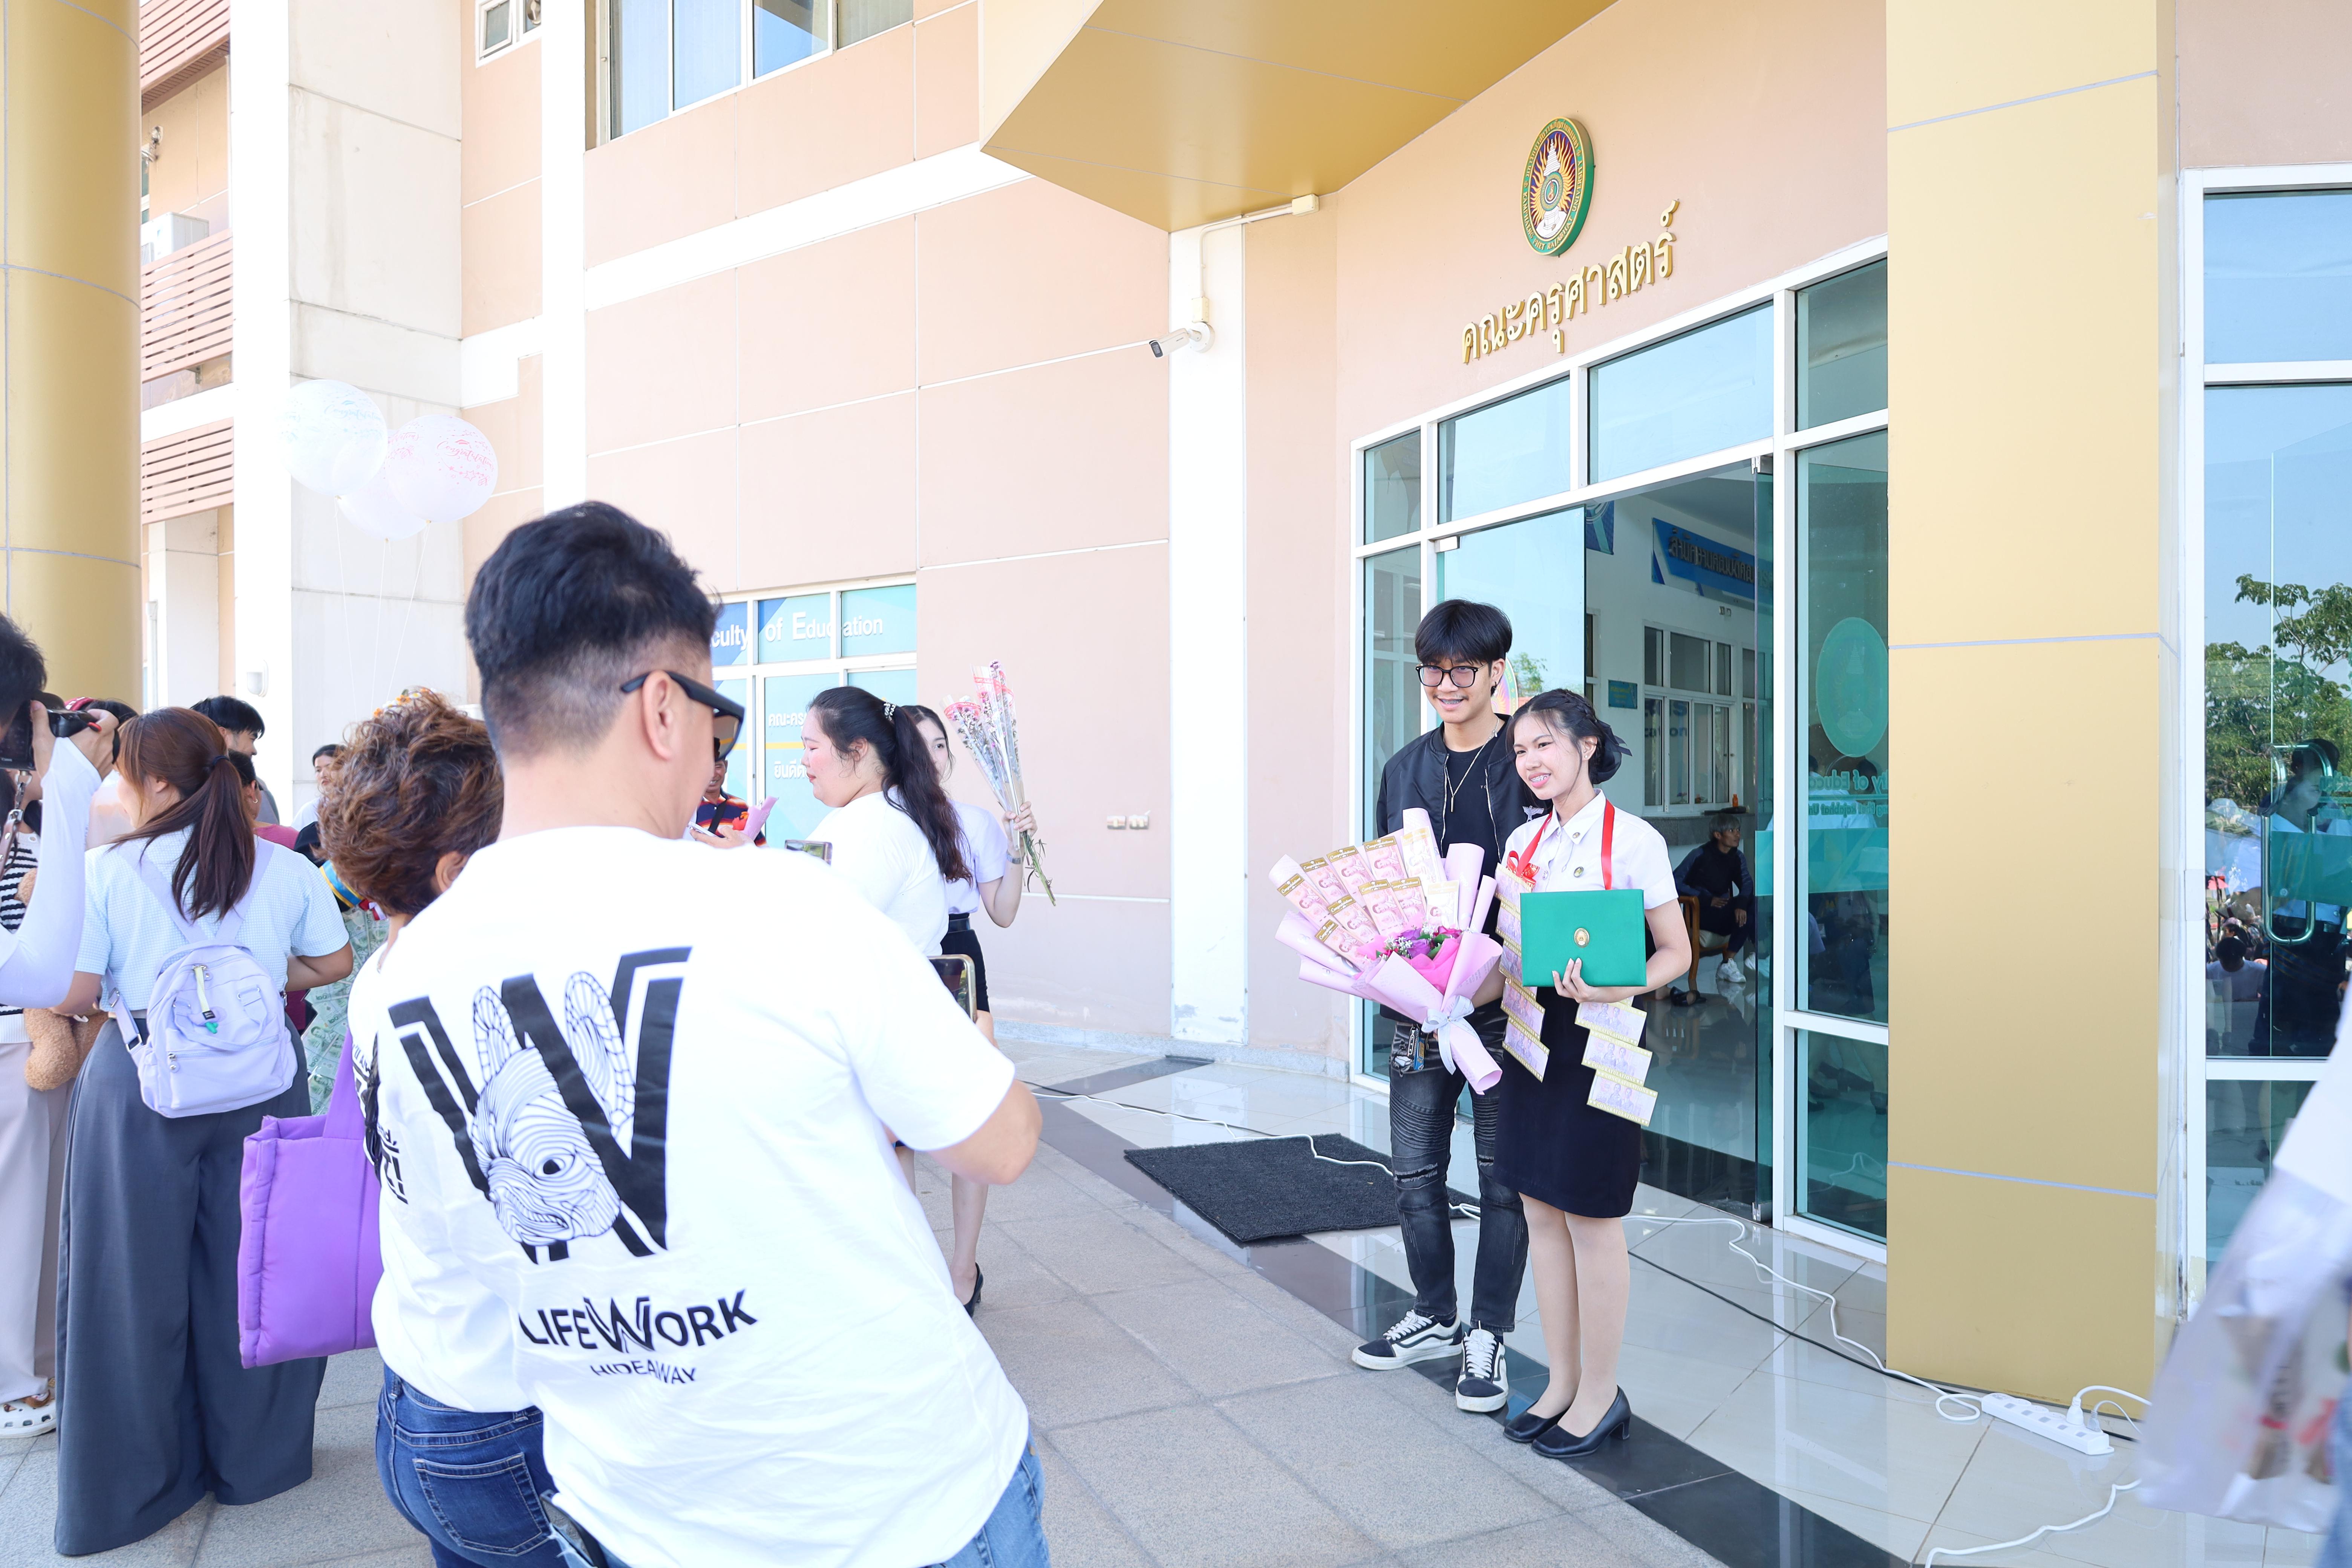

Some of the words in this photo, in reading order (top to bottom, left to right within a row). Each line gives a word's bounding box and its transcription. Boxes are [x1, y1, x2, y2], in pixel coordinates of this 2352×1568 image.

[1522, 191, 1534, 240] KAMPHAENG
[1533, 238, 1545, 250] PHET
[1547, 217, 1574, 250] RAJABHAT
[1571, 159, 1583, 212] UNIVERSITY
[1461, 199, 1680, 364] คณะครุศาสตร์
[712, 624, 748, 650] culty
[765, 617, 783, 642] of
[1513, 1021, 1544, 1049] CONGRATULATIONS
[1585, 1022, 1629, 1042] CONGRATULATIONS
[1507, 1047, 1537, 1075] CONGRATULATIONS
[1591, 1062, 1635, 1082] CONGRATULATIONS
[1605, 1073, 1648, 1093] CONGRATULATIONS
[1597, 1102, 1640, 1122] CONGRATULATIONS
[519, 1289, 758, 1352] LIFEWORK
[590, 1358, 697, 1384] HIDEAWAY
